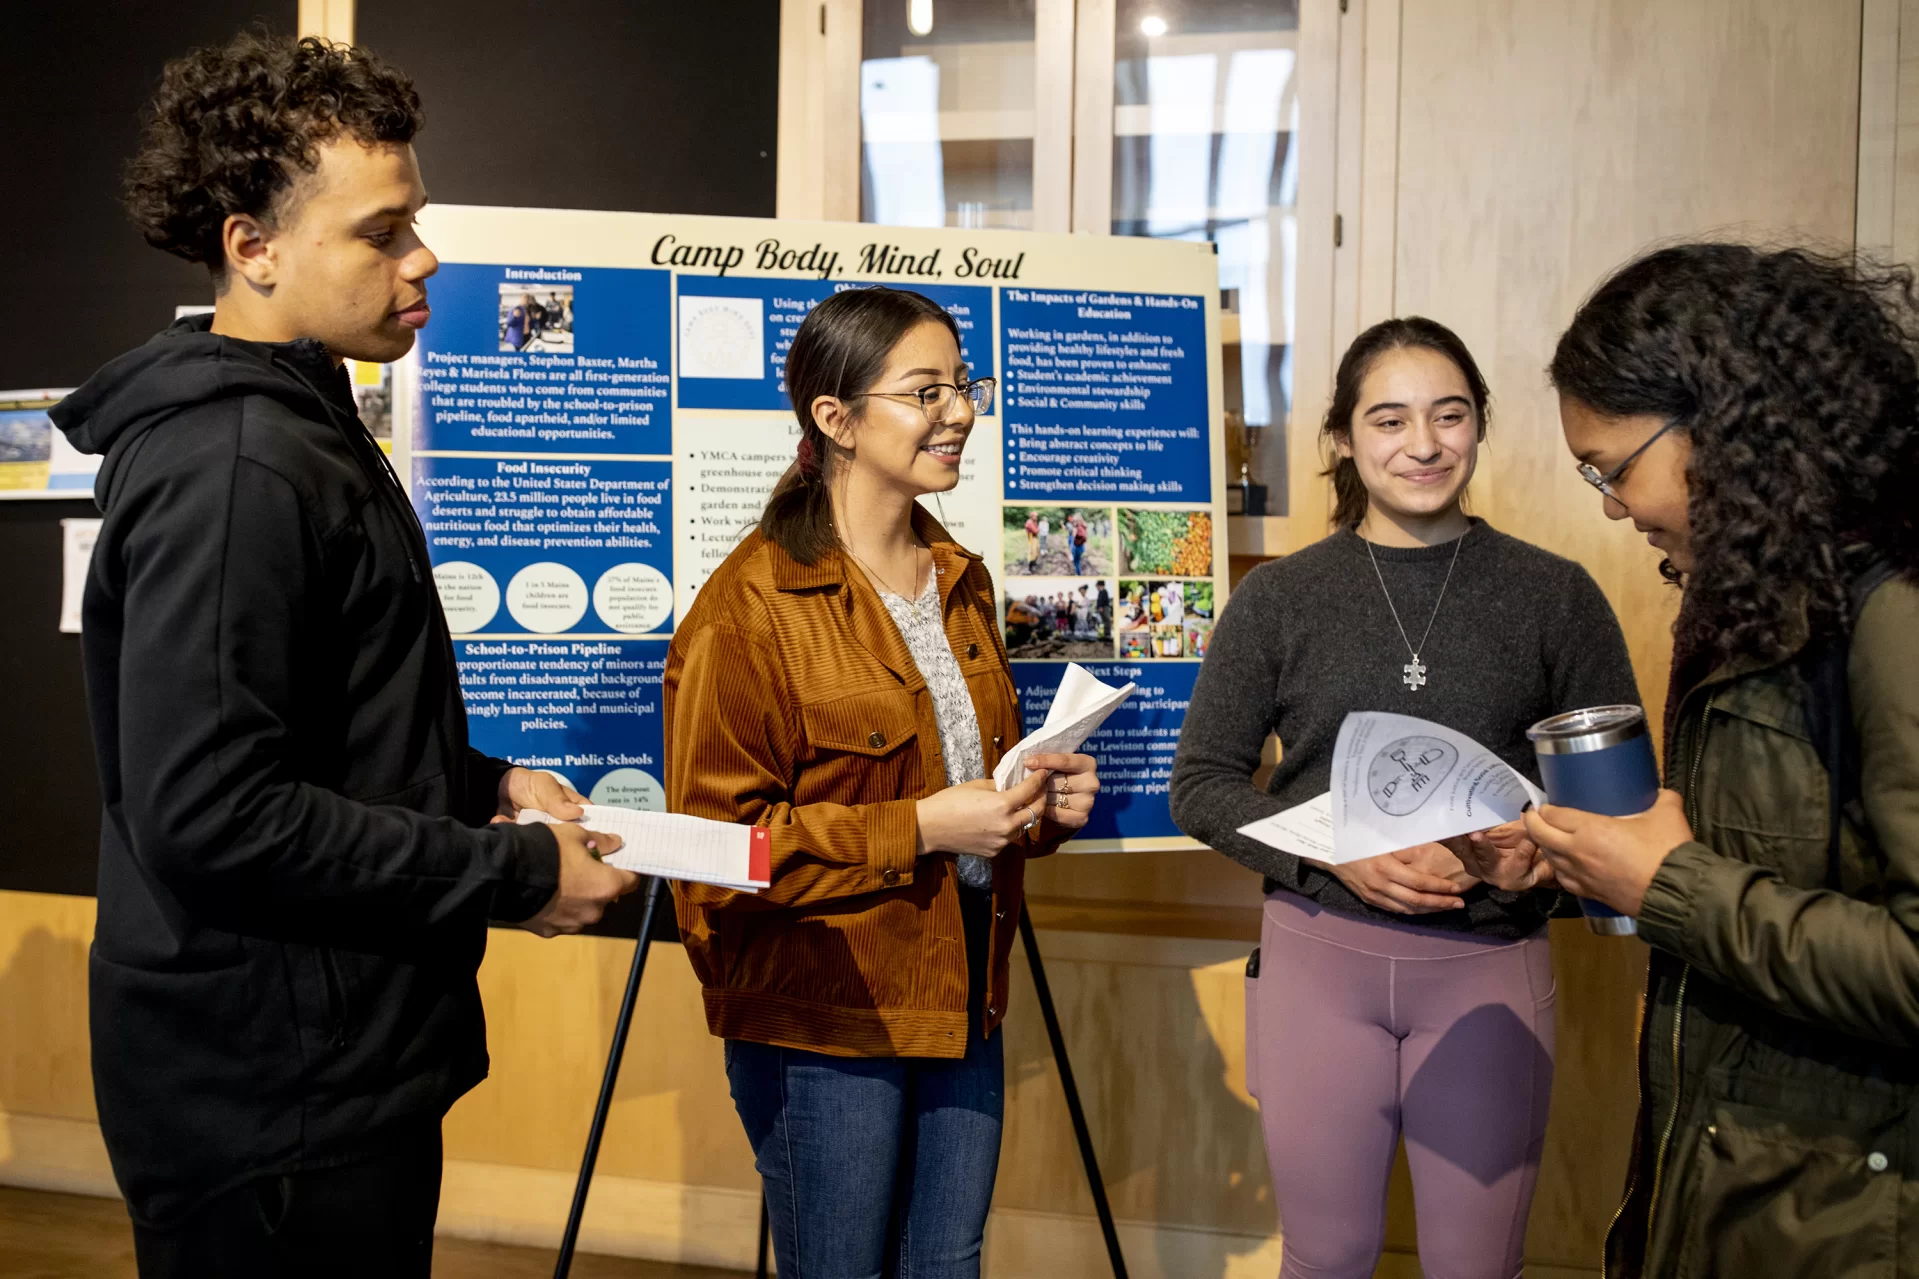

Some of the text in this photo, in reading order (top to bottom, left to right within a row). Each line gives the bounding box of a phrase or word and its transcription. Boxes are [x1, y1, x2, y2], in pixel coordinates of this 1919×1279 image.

[650, 234, 1025, 279] Camp Body, Mind, Soul
[505, 268, 582, 281] Introduction
[1007, 290, 1198, 309] The Impacts of Gardens Hands-On
[1078, 307, 1131, 320] Education
[1008, 328, 1160, 343] Working gardens, addition
[1008, 343, 1184, 358] providing healthy lifestyles and fresh
[428, 352, 657, 368] Project managers, Stephon Baxter, Martha
[1009, 356, 1171, 371] food, has been proven enhance:
[462, 368, 669, 384] Marisela Flores are all first-generation
[1064, 372, 1109, 382] academic
[1112, 373, 1172, 384] achievement
[460, 382, 507, 393] students
[509, 383, 532, 395] who
[536, 386, 565, 395] come
[568, 384, 594, 395] from
[597, 385, 666, 397] communities
[1018, 383, 1150, 399] Environmental stewardship
[432, 397, 653, 413] that are troubled the school-to-prison
[1018, 398, 1145, 411] Social Community skills
[436, 411, 649, 425] pipeline, food apartheid, and/or limited
[471, 426, 615, 440] educational opportunities.
[1010, 424, 1199, 440] This hands-on learning experience will:
[1019, 438, 1163, 453] Bring abstract concepts life
[701, 452, 737, 461] YMCA
[1019, 452, 1119, 465] Encourage creativity
[497, 462, 591, 476] Food Insecurity
[701, 469, 762, 477] greenhouse
[1019, 467, 1142, 479] Promote critical thinking
[417, 476, 669, 491] According the United States Department of
[1019, 480, 1182, 493] Strengthen decision making skills
[425, 491, 661, 506] Agriculture, 23.5 million people live food
[701, 501, 761, 510] garden and
[432, 506, 653, 520] deserts and struggle obtain affordable
[426, 520, 660, 535] nutritious food that optimizes their health,
[702, 517, 731, 525] Work
[433, 535, 652, 549] energy, and disease prevention abilities.
[466, 644, 621, 656] School-to-Prison Pipeline
[456, 659, 666, 672] proportionate tendency of minors and
[1114, 666, 1141, 678] Steps
[489, 673, 664, 686] from disadvantaged background
[462, 688, 641, 700] become incarcerated, because of
[503, 702, 654, 715] harsh school and municipal
[1139, 700, 1189, 712] participan
[521, 719, 567, 732] policies.
[1127, 727, 1167, 737] students
[1083, 741, 1098, 750] the
[1100, 741, 1144, 751] Lewiston
[508, 753, 653, 767] Lewiston Public Schools
[1109, 755, 1173, 765] become more
[1113, 783, 1143, 795] prison
